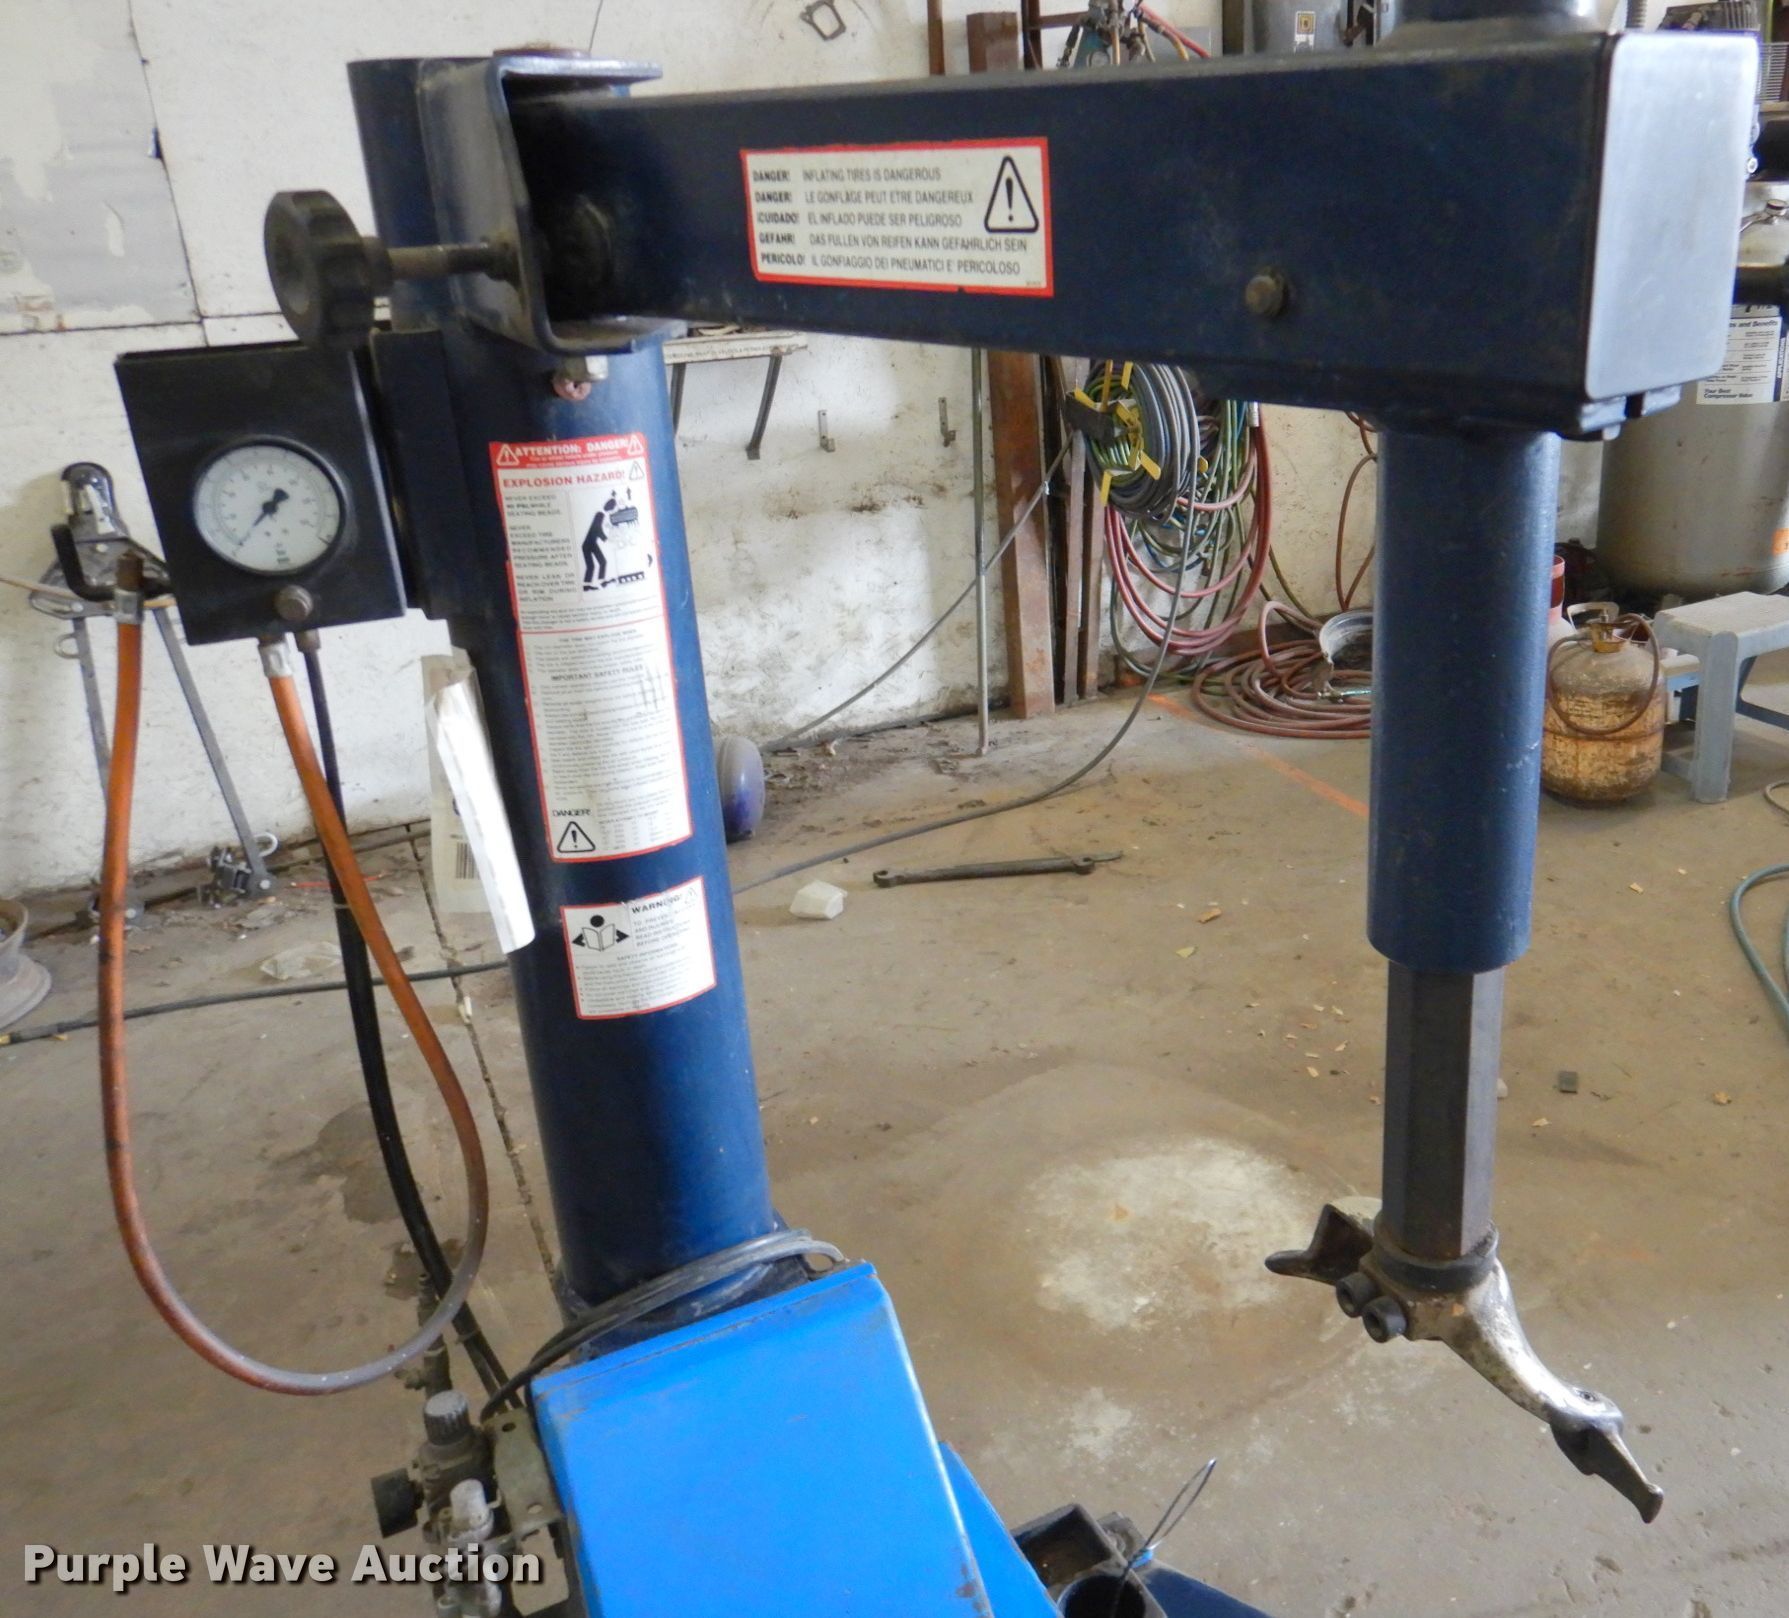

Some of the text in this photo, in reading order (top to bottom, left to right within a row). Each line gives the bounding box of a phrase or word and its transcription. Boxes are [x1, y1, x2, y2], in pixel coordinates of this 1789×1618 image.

[753, 167, 941, 182] DANGER! INFLATING TIRES IS DANGEROUS
[755, 191, 792, 203] DANGER!
[805, 191, 816, 204] LE
[865, 191, 887, 204] PEUT
[915, 190, 974, 204] DANGEREUX
[808, 213, 818, 225] EL
[820, 213, 856, 226] INFLADO
[858, 213, 886, 226] PUEDE
[888, 213, 906, 226] SER
[908, 213, 962, 227] PELIGROSO
[809, 233, 827, 246] DAS
[861, 234, 880, 247] VON
[881, 235, 913, 249] REIFEN
[914, 236, 940, 250] KANN
[1004, 237, 1027, 252] SEIN
[761, 252, 805, 265] PERICOLO!
[811, 255, 820, 267] IL
[821, 255, 873, 269] GONFIAGGIO
[875, 256, 889, 270] DEI
[891, 257, 945, 272] PNEUMATICI
[957, 260, 1020, 275] PERICOLOSO
[515, 443, 581, 457] ATTENTION:
[503, 470, 625, 488] EXPLOSION HAZARD!
[551, 664, 643, 682] IMPORTANT SAFETY RULES
